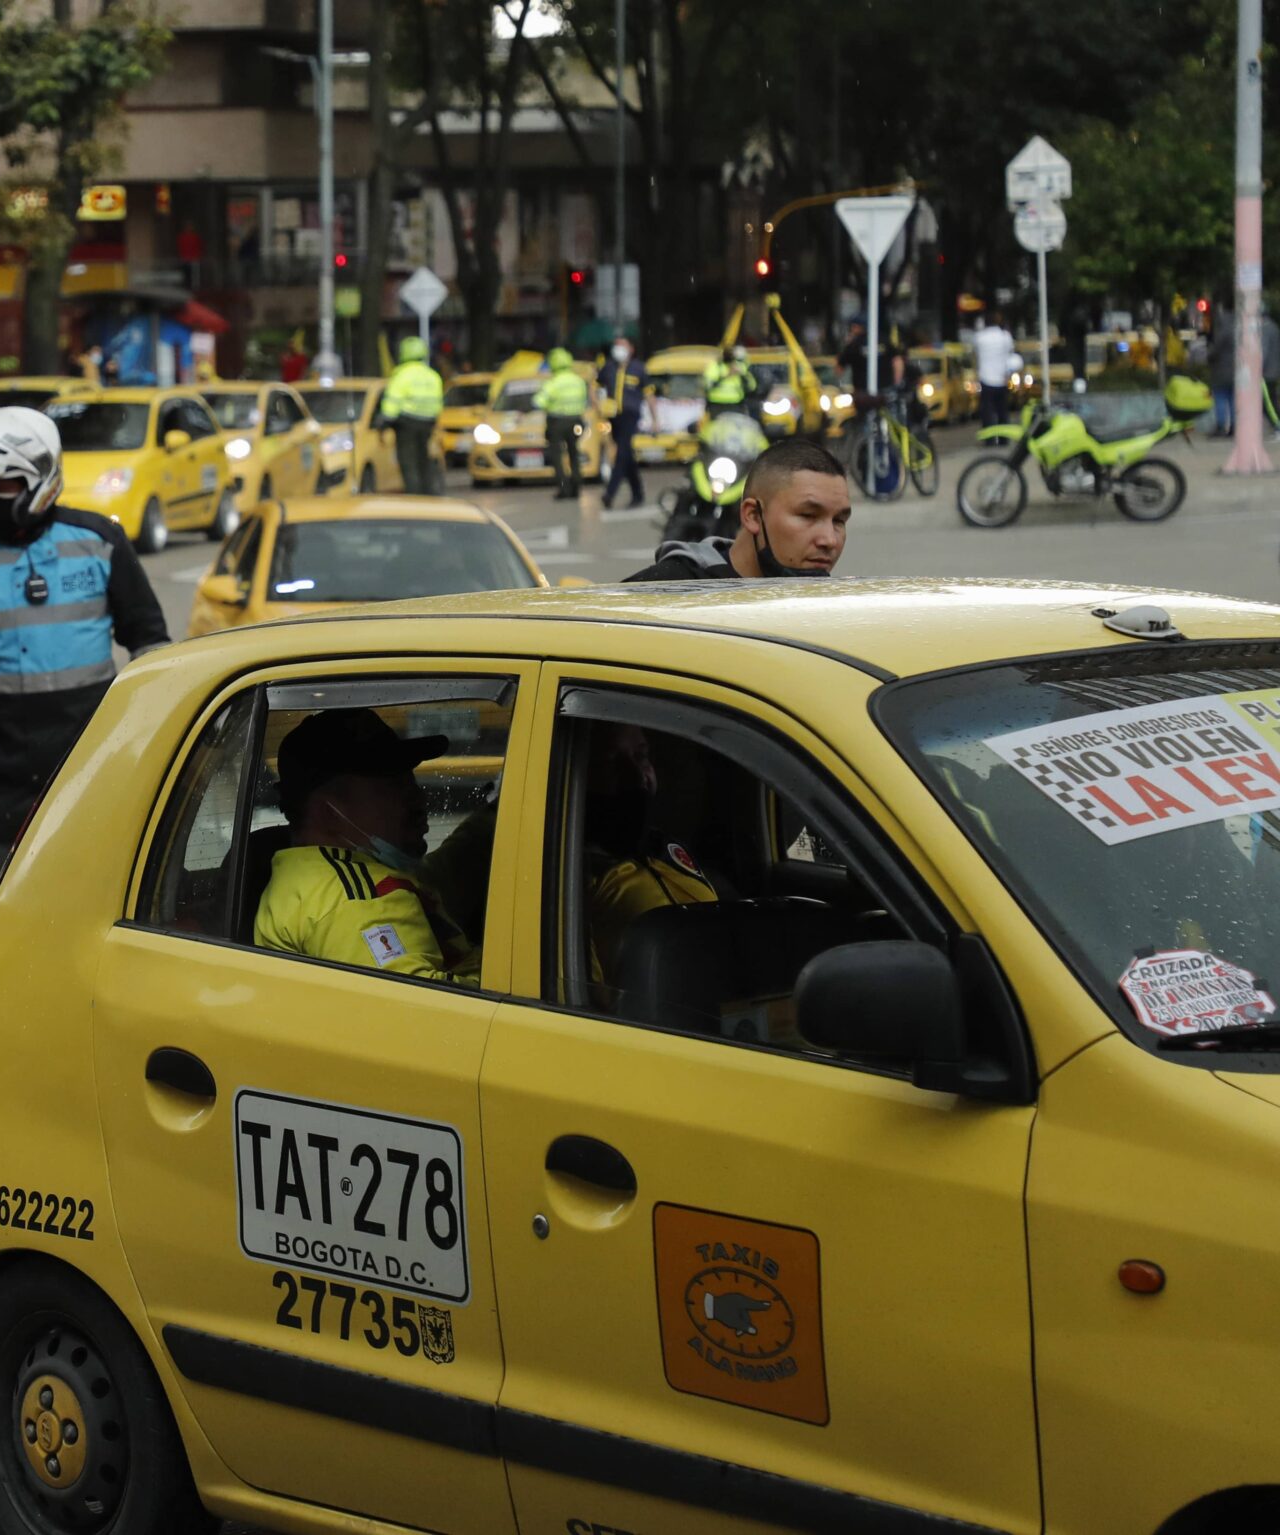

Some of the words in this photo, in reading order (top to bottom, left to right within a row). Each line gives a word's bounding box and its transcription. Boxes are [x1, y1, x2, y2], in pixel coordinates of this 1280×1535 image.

[1030, 729, 1112, 758] SEÑORES
[1107, 709, 1228, 741] CONGRESISTAS
[1239, 700, 1280, 722] PL
[1047, 751, 1121, 785] NO
[1112, 725, 1262, 769] VIOLEN
[1083, 775, 1196, 827] LA
[1128, 955, 1216, 981] CRUZADA
[1149, 970, 1215, 990] NACIONAL
[1141, 990, 1166, 1009] DE
[1166, 976, 1252, 1003] TAXISTAS
[1153, 1007, 1171, 1023] 25
[1170, 1005, 1188, 1021] DE
[1188, 989, 1257, 1016] NOVIEMBRE
[241, 1120, 339, 1225] TAT
[350, 1143, 458, 1250] 278
[275, 1232, 379, 1275] BOGOTA
[385, 1256, 434, 1287] D.C.
[695, 1242, 780, 1280] TAXIS
[272, 1270, 420, 1357] 27735
[687, 1337, 704, 1357] A
[705, 1347, 734, 1377] LA
[735, 1355, 799, 1383] MANO
